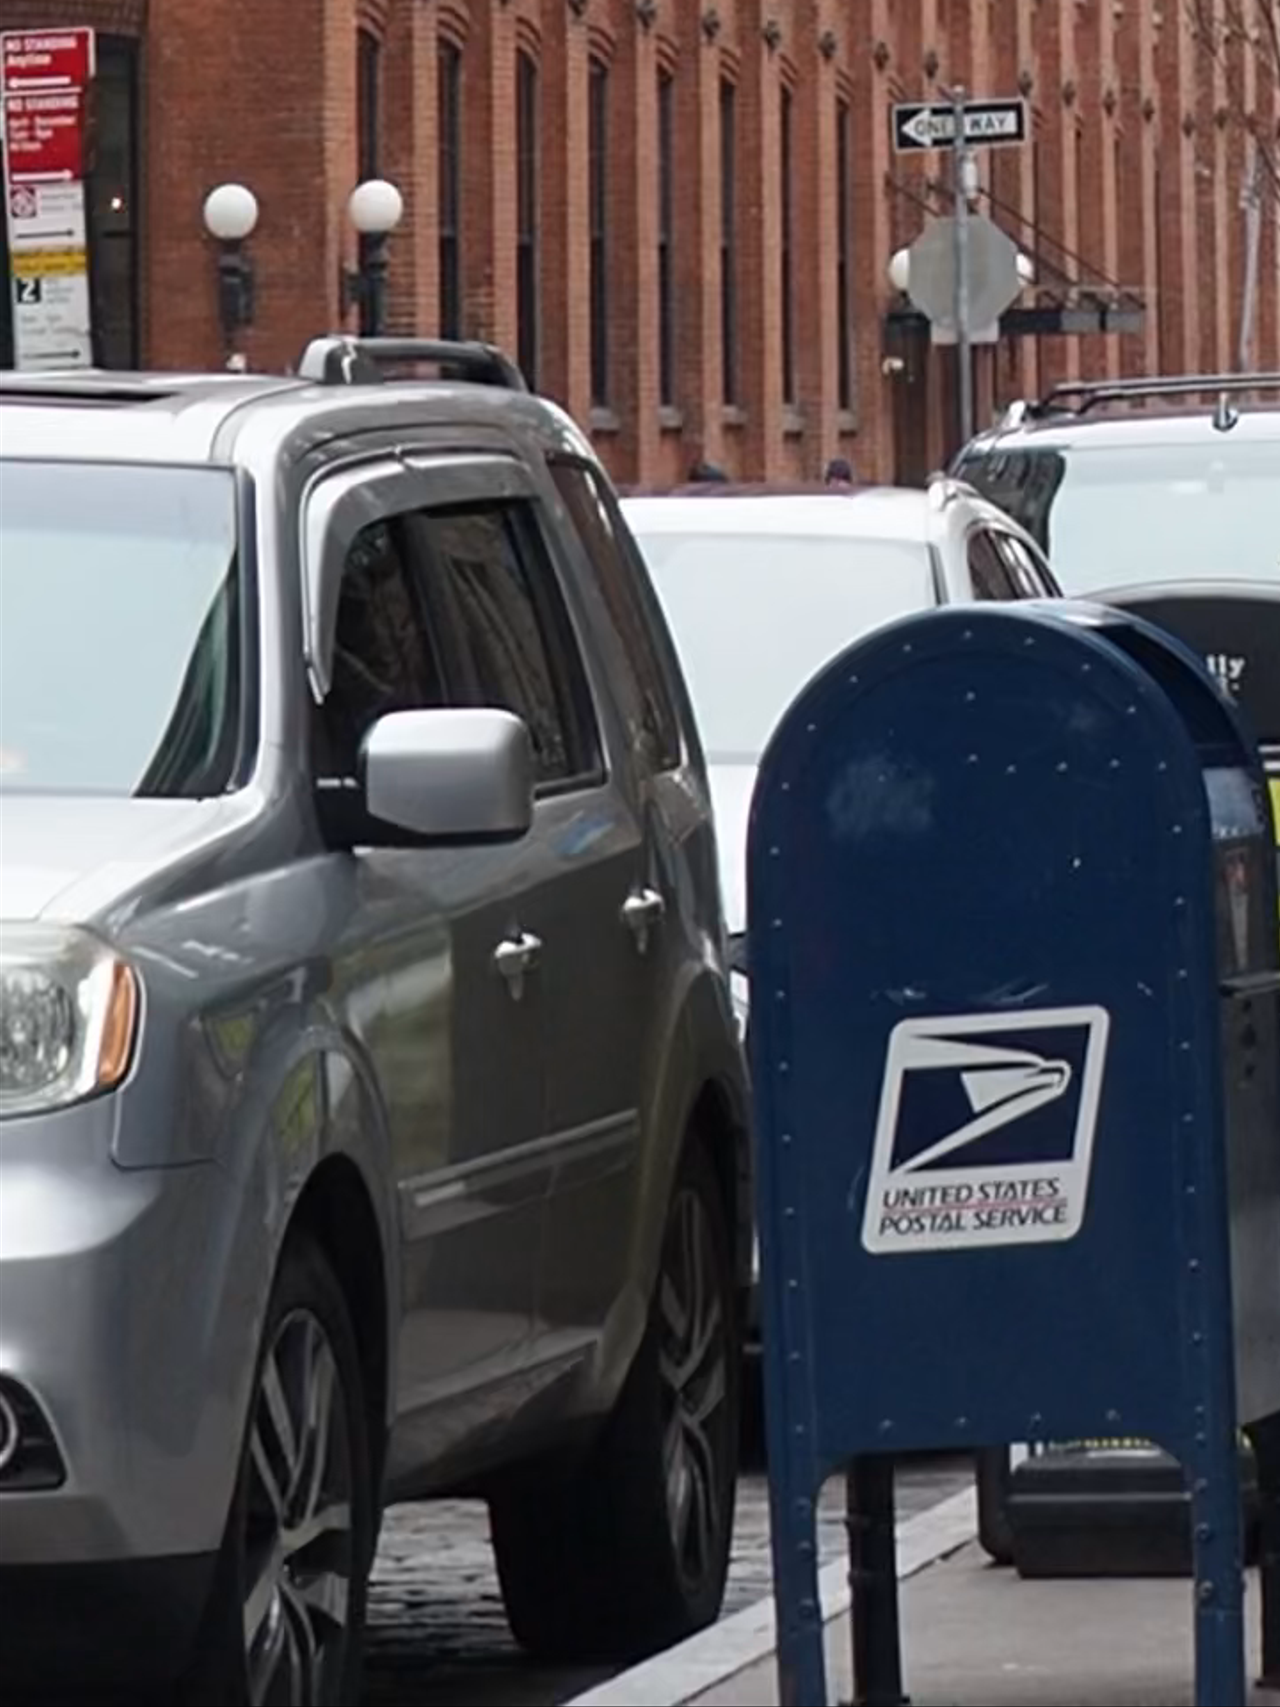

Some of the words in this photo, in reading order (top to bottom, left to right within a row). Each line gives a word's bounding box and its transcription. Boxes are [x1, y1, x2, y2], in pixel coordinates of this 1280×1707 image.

[882, 1183, 974, 1209] UNITED
[977, 1177, 1061, 1201] STATES
[878, 1213, 968, 1236] POSTAL
[973, 1205, 1068, 1231] SERVICE
